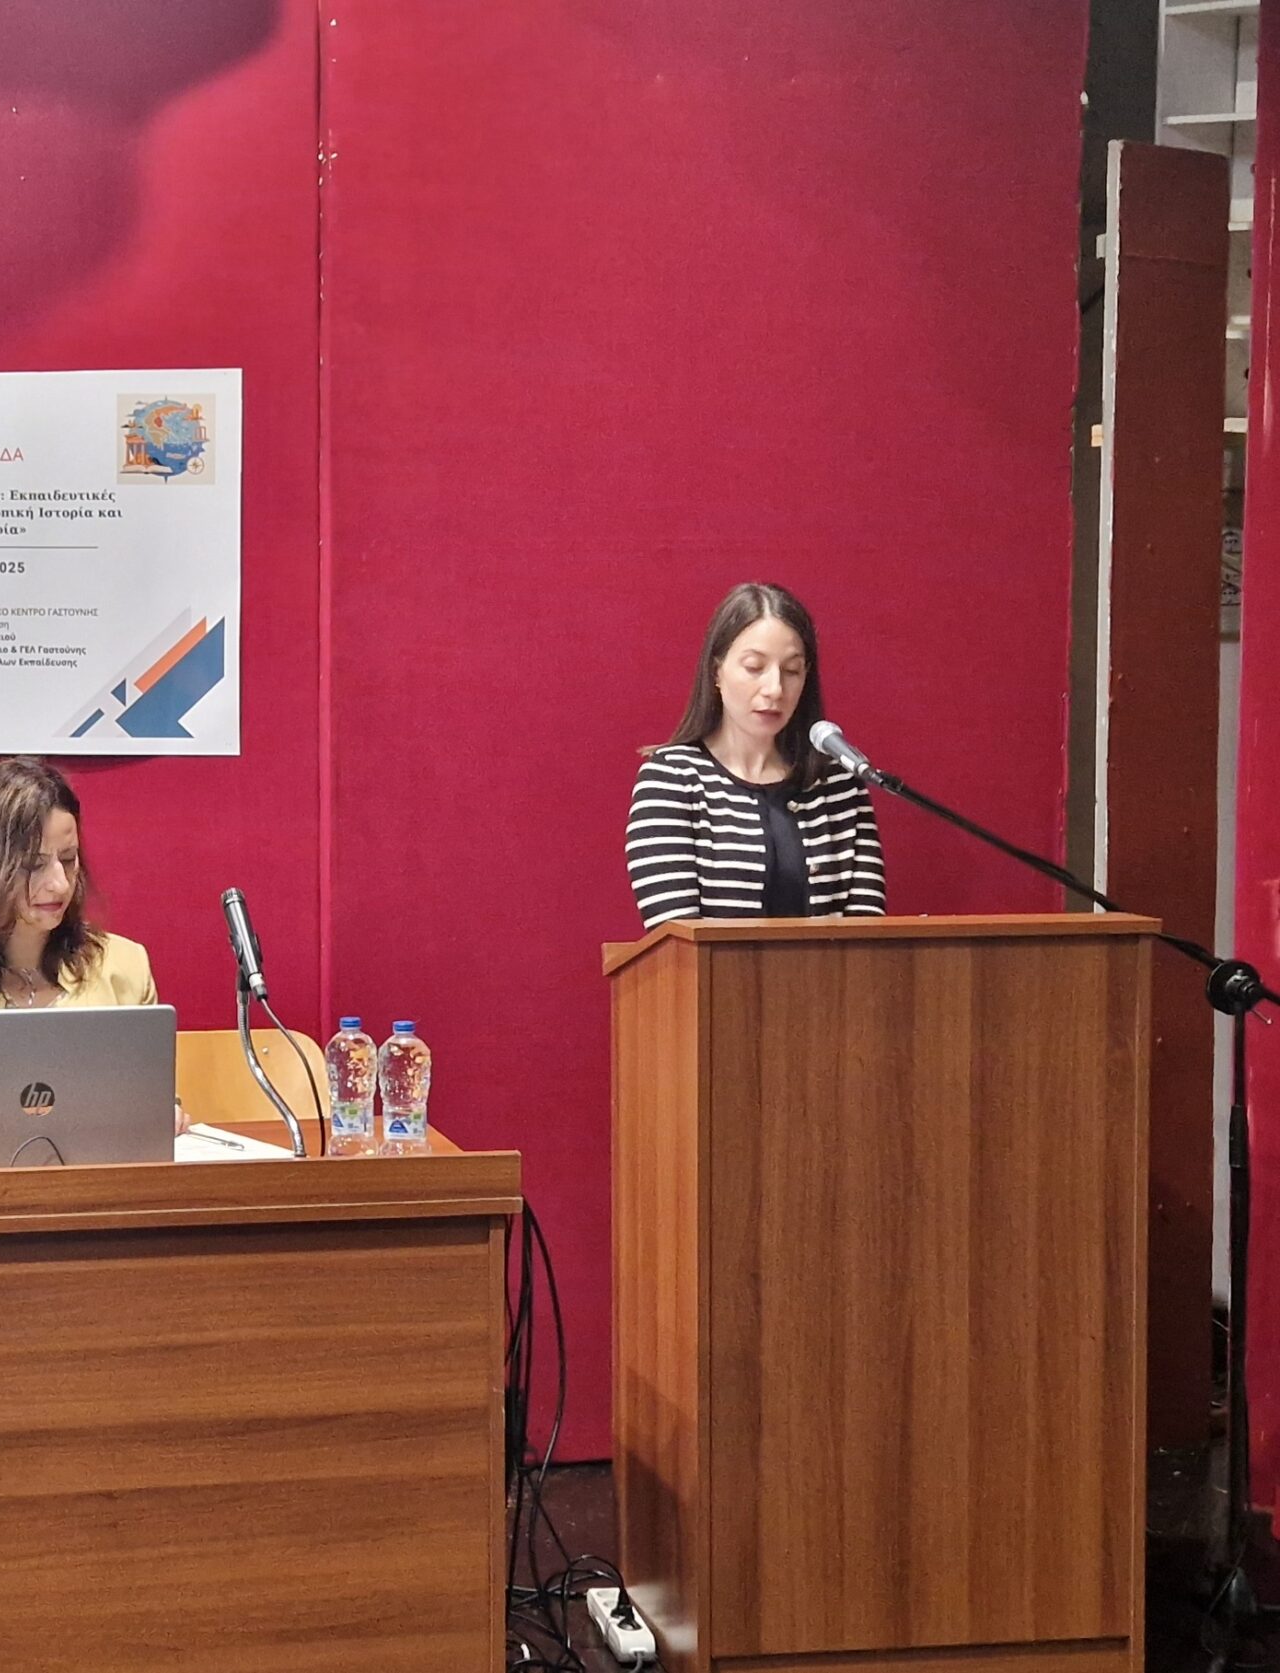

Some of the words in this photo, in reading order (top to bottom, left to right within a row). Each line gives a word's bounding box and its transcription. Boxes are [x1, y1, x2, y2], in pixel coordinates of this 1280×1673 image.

[10, 488, 116, 503] Εκπαιδευτικές
[39, 506, 93, 520] Ιστορία
[98, 508, 123, 518] και
[11, 607, 46, 617] ΚΕΝΤΡΟ
[48, 607, 99, 617] ΓΑΣΤΟΥΝΗΣ
[20, 645, 36, 653] ΓΕΛ
[38, 645, 87, 655] Γαστούνης
[19, 657, 78, 668] Εκπαίδευσης
[21, 1082, 54, 1117] hp
